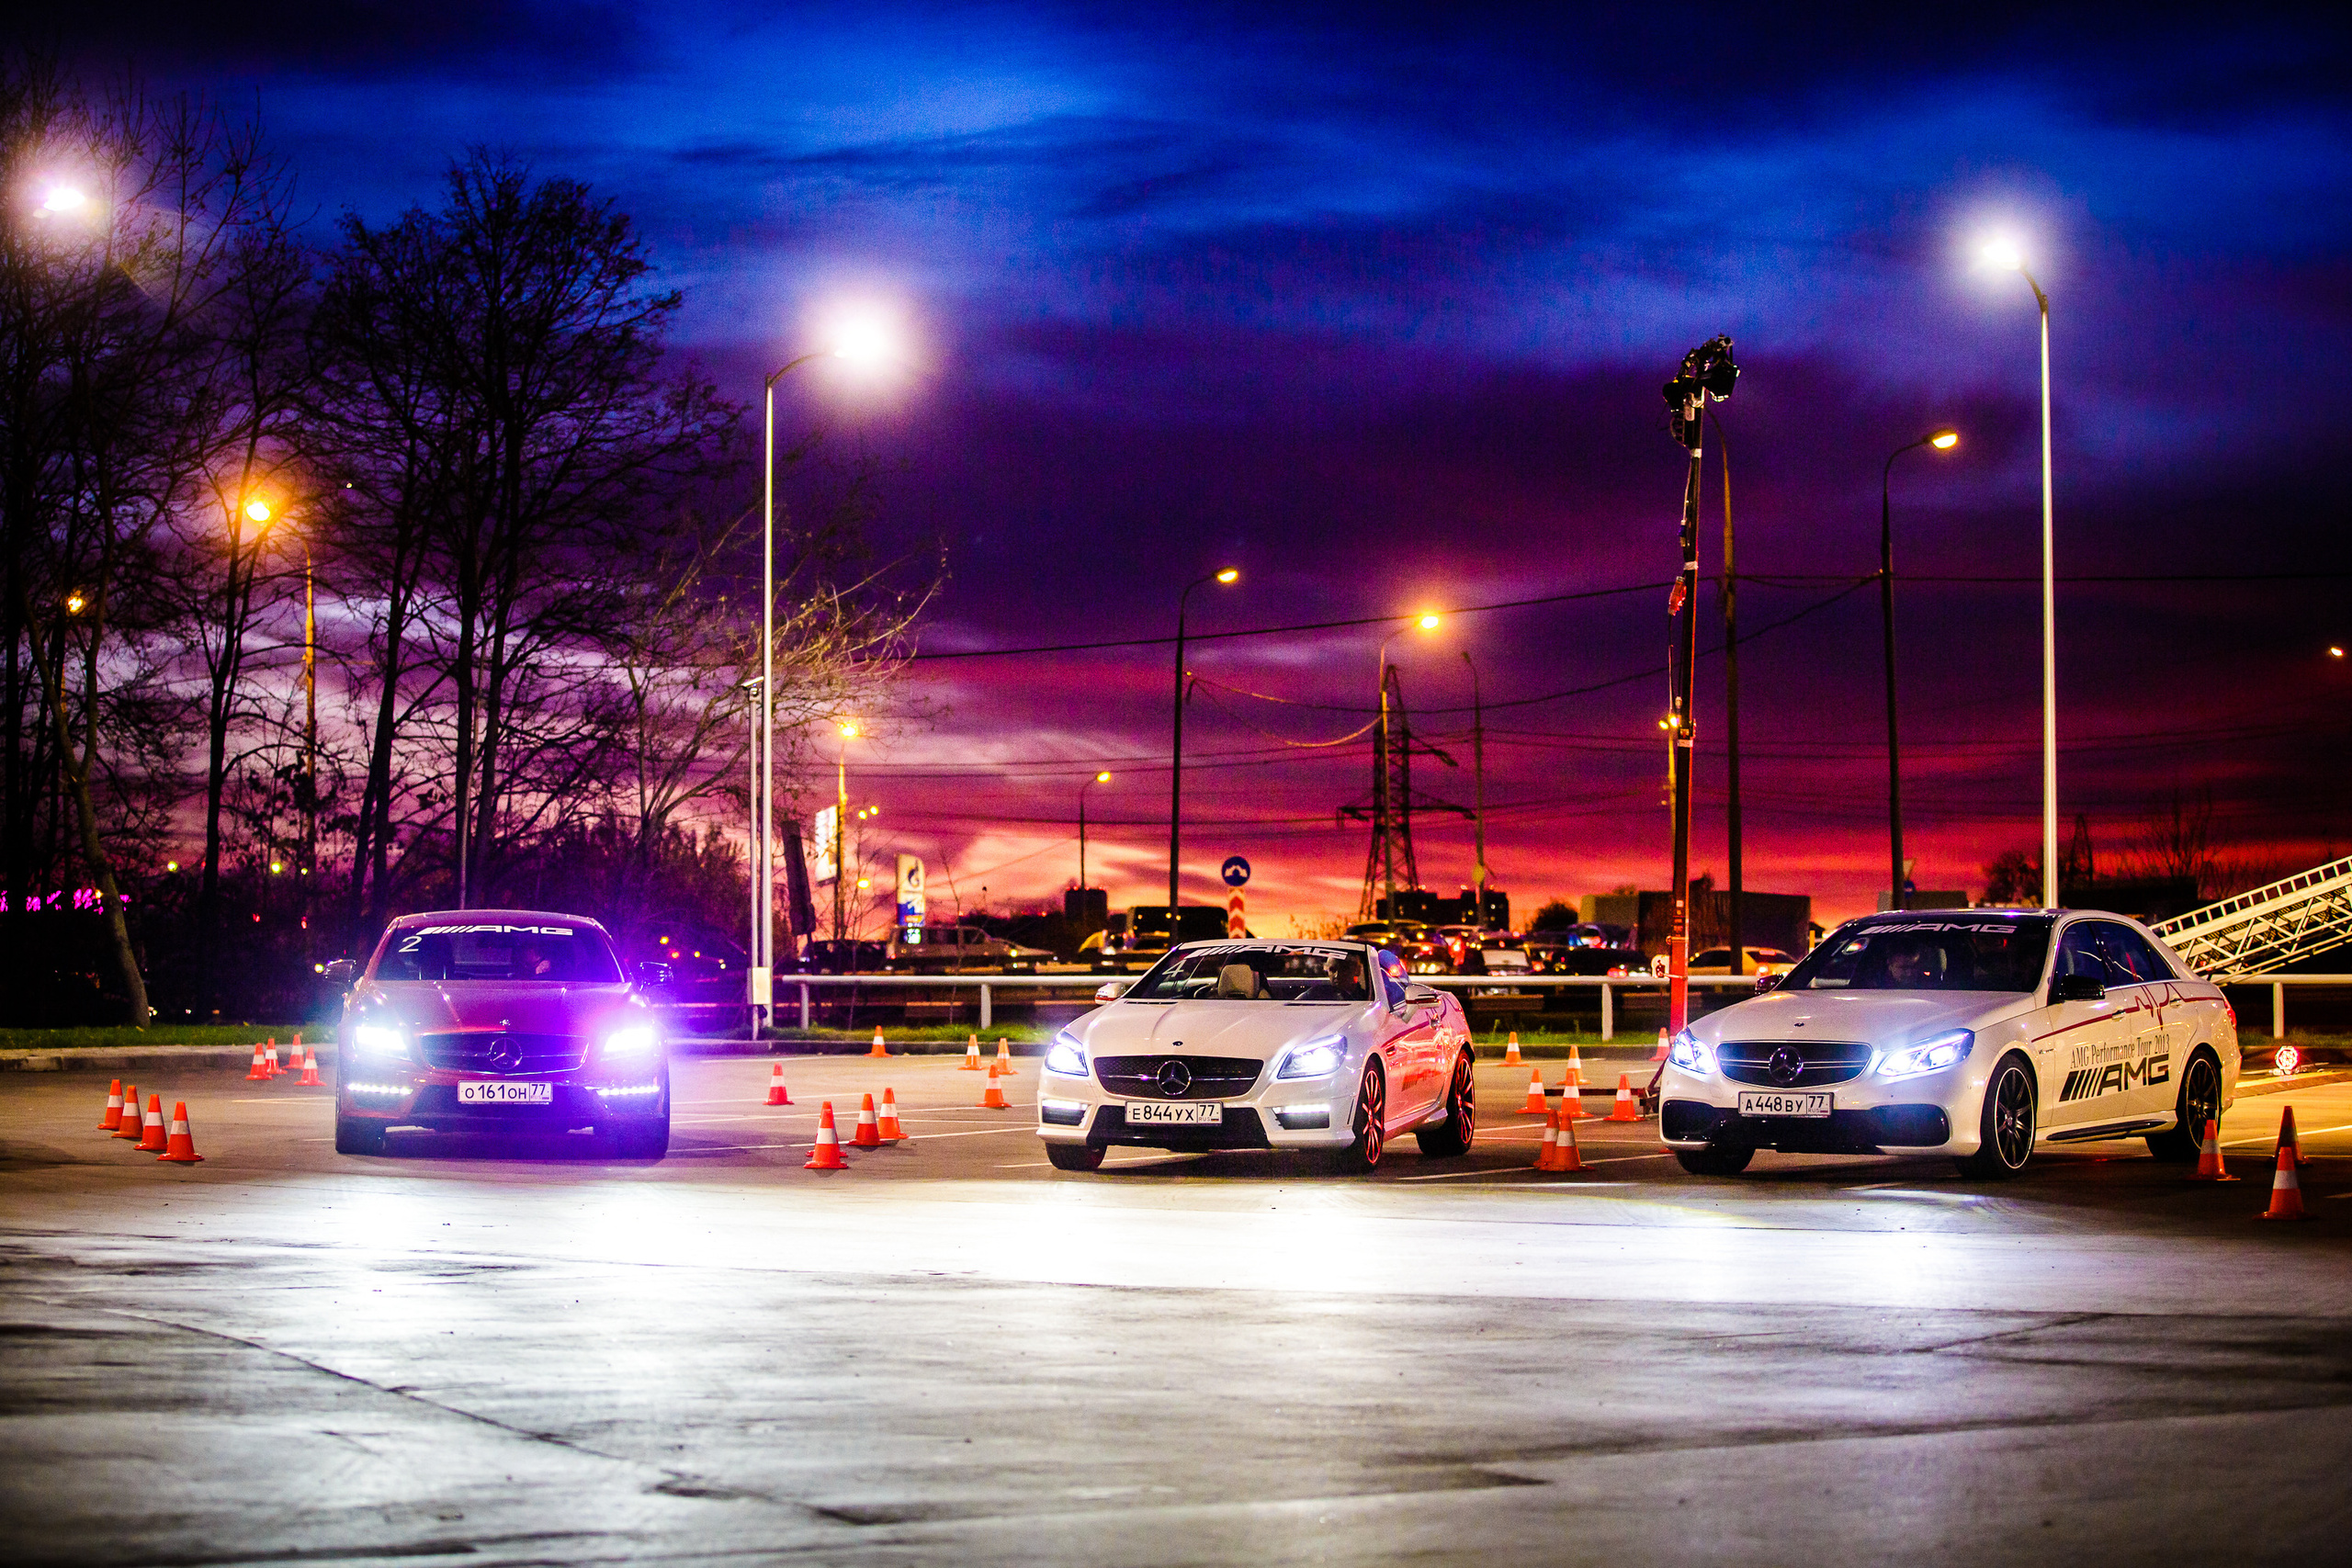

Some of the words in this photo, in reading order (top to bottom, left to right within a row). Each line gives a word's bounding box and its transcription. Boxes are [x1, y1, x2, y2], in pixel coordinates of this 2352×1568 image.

[398, 936, 423, 953] 2
[1162, 960, 1187, 978] 4
[2070, 1046, 2090, 1069] AMG
[2091, 1042, 2135, 1065] Performance
[2137, 1037, 2153, 1056] Tour
[2154, 1033, 2170, 1055] 2013
